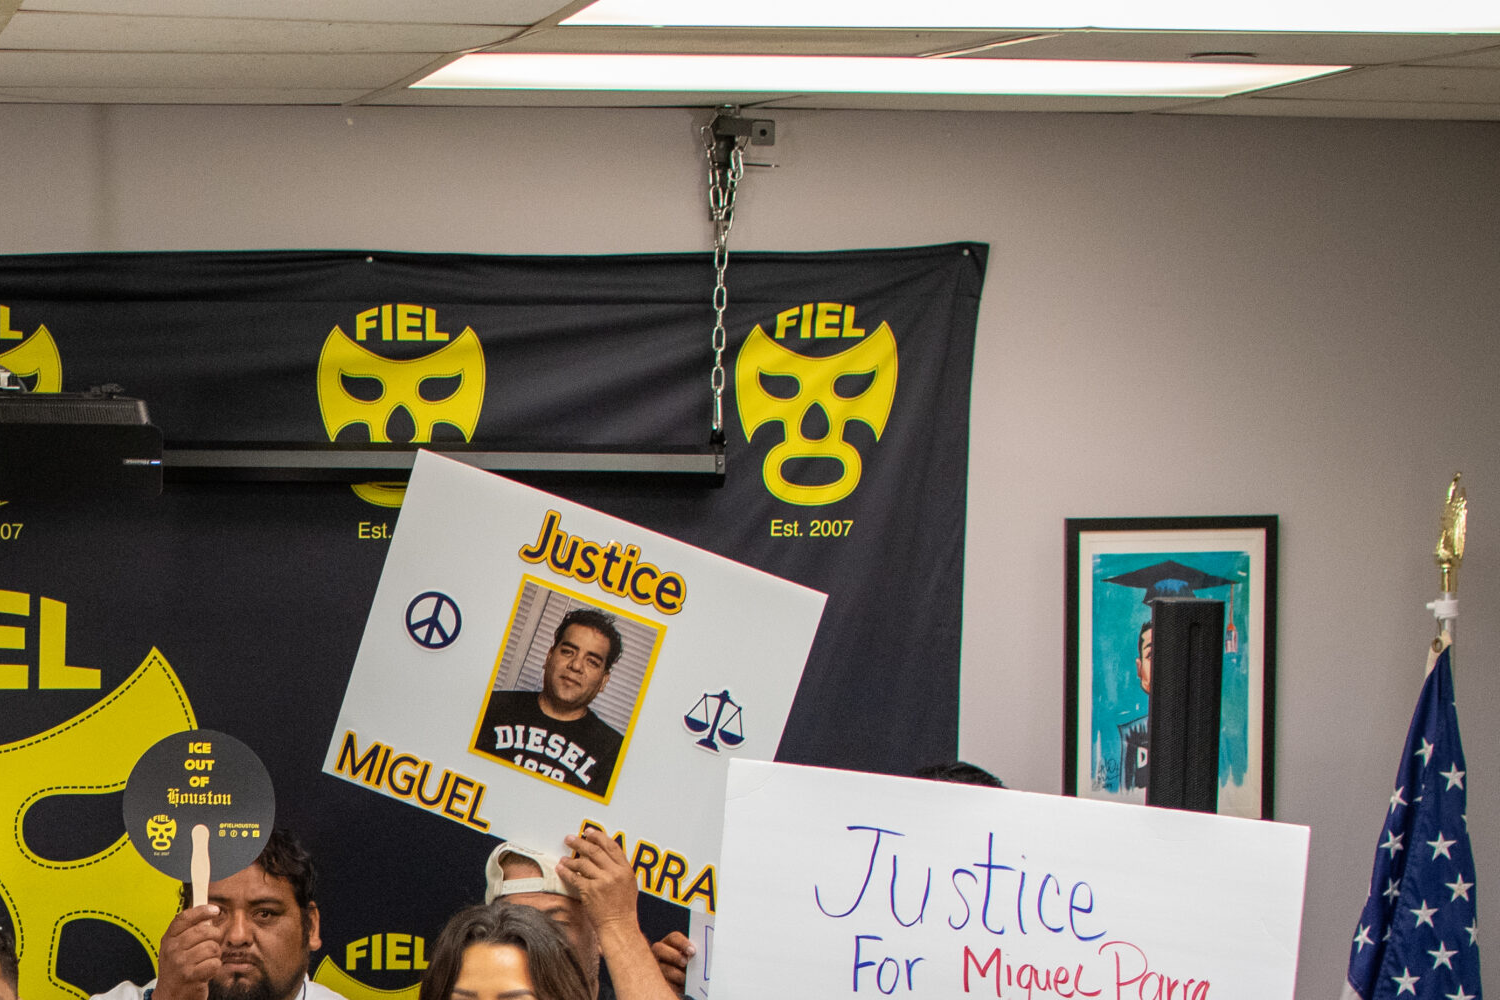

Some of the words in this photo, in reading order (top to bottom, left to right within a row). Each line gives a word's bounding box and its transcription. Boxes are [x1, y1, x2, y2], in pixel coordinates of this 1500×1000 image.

[356, 303, 450, 341] FIEL
[774, 302, 866, 340] FIEL
[357, 521, 392, 539] Est.
[770, 519, 803, 538] Est.
[809, 519, 853, 538] 2007
[519, 510, 686, 615] Justice
[184, 759, 215, 771] OUT
[188, 742, 212, 754] ICE
[493, 724, 597, 785] DIESEL
[167, 788, 232, 808] Houston
[189, 775, 210, 788] OF
[336, 731, 491, 833] MIGUEL
[153, 814, 171, 823] FIEL
[815, 824, 1107, 941] Justice
[346, 932, 430, 971] FIEL
[853, 935, 926, 995] For
